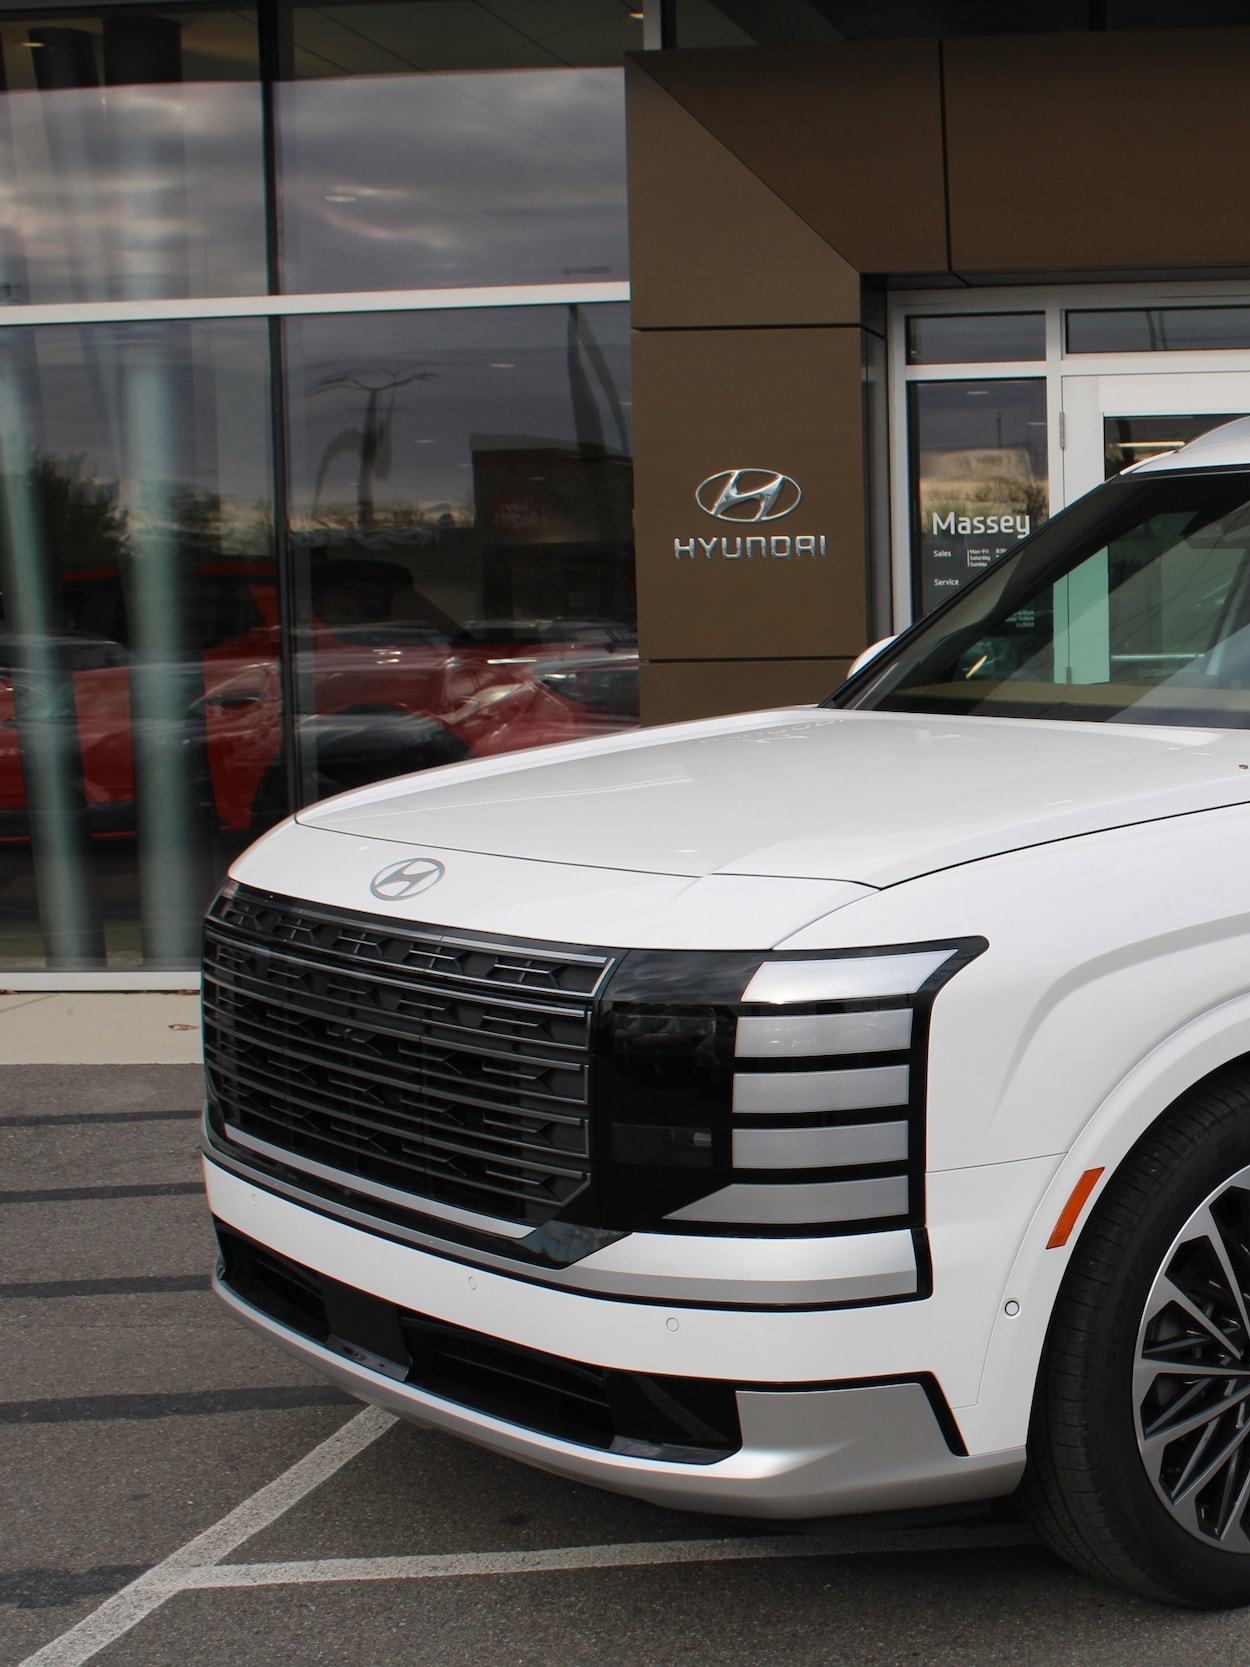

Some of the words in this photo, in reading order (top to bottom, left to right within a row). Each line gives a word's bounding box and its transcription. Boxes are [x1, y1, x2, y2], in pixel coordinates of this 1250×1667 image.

[932, 512, 1031, 539] Massey
[674, 535, 827, 560] HYUNDAI
[933, 549, 952, 557] Sales
[934, 578, 960, 586] Service
